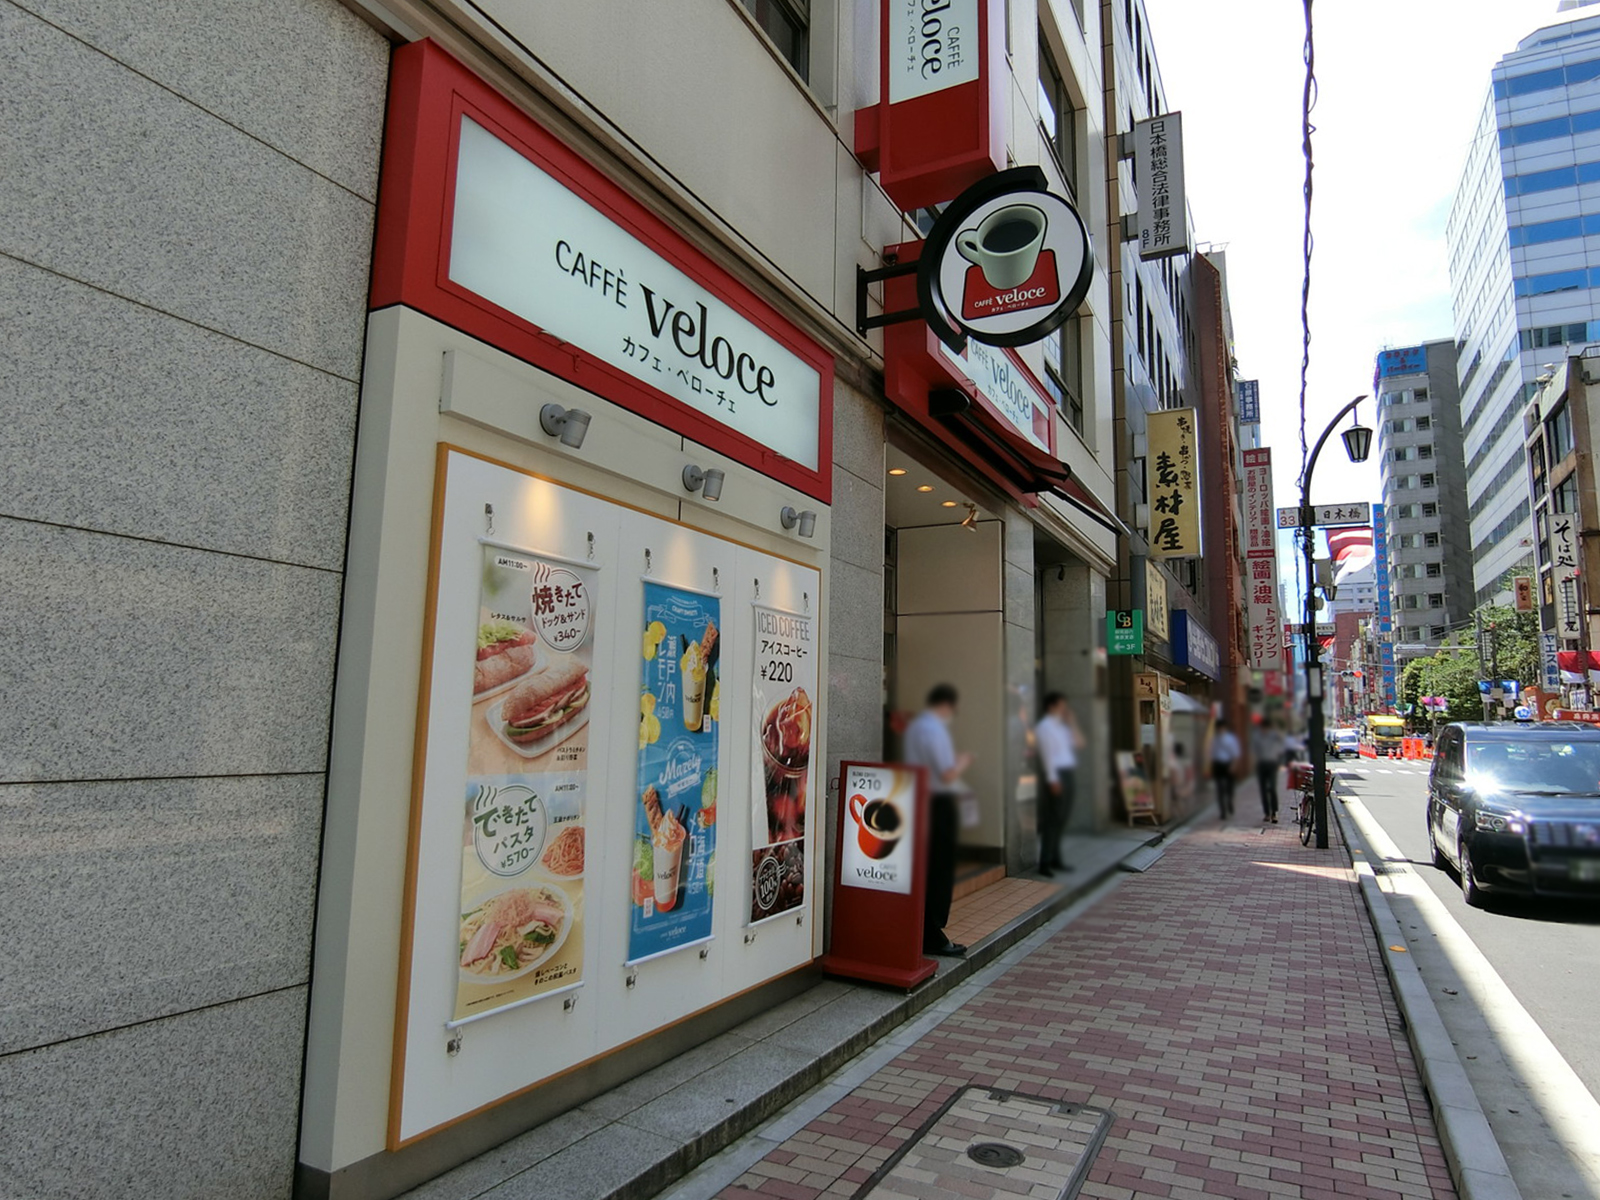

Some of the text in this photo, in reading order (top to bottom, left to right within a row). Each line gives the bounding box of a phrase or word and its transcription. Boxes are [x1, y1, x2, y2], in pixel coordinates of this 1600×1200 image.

[947, 26, 965, 70] CAFFÈ
[1149, 120, 1171, 247] 日本橋総合法律事務所
[1142, 229, 1150, 249] 8F
[995, 286, 1047, 306] veloce
[555, 239, 779, 407] CAFFÈ veloce
[621, 335, 736, 414] カフェ・ベローチェ
[990, 355, 1031, 420] veloce
[1153, 451, 1184, 551] 素材屋
[1323, 507, 1362, 520] 日本橋
[1280, 515, 1296, 526] 33
[1553, 519, 1577, 568] そば処
[532, 582, 583, 617] 焼きたて
[1252, 560, 1273, 605] 絵画・油絵
[757, 611, 811, 642] ICED COFFEE
[761, 639, 808, 658] アイスコーヒー
[1252, 625, 1264, 668] ギャラリー
[760, 660, 793, 683] ¥220
[852, 777, 882, 791] ¥210
[474, 794, 538, 838] できたて
[493, 825, 534, 854] パスタ
[856, 866, 898, 881] veloce
